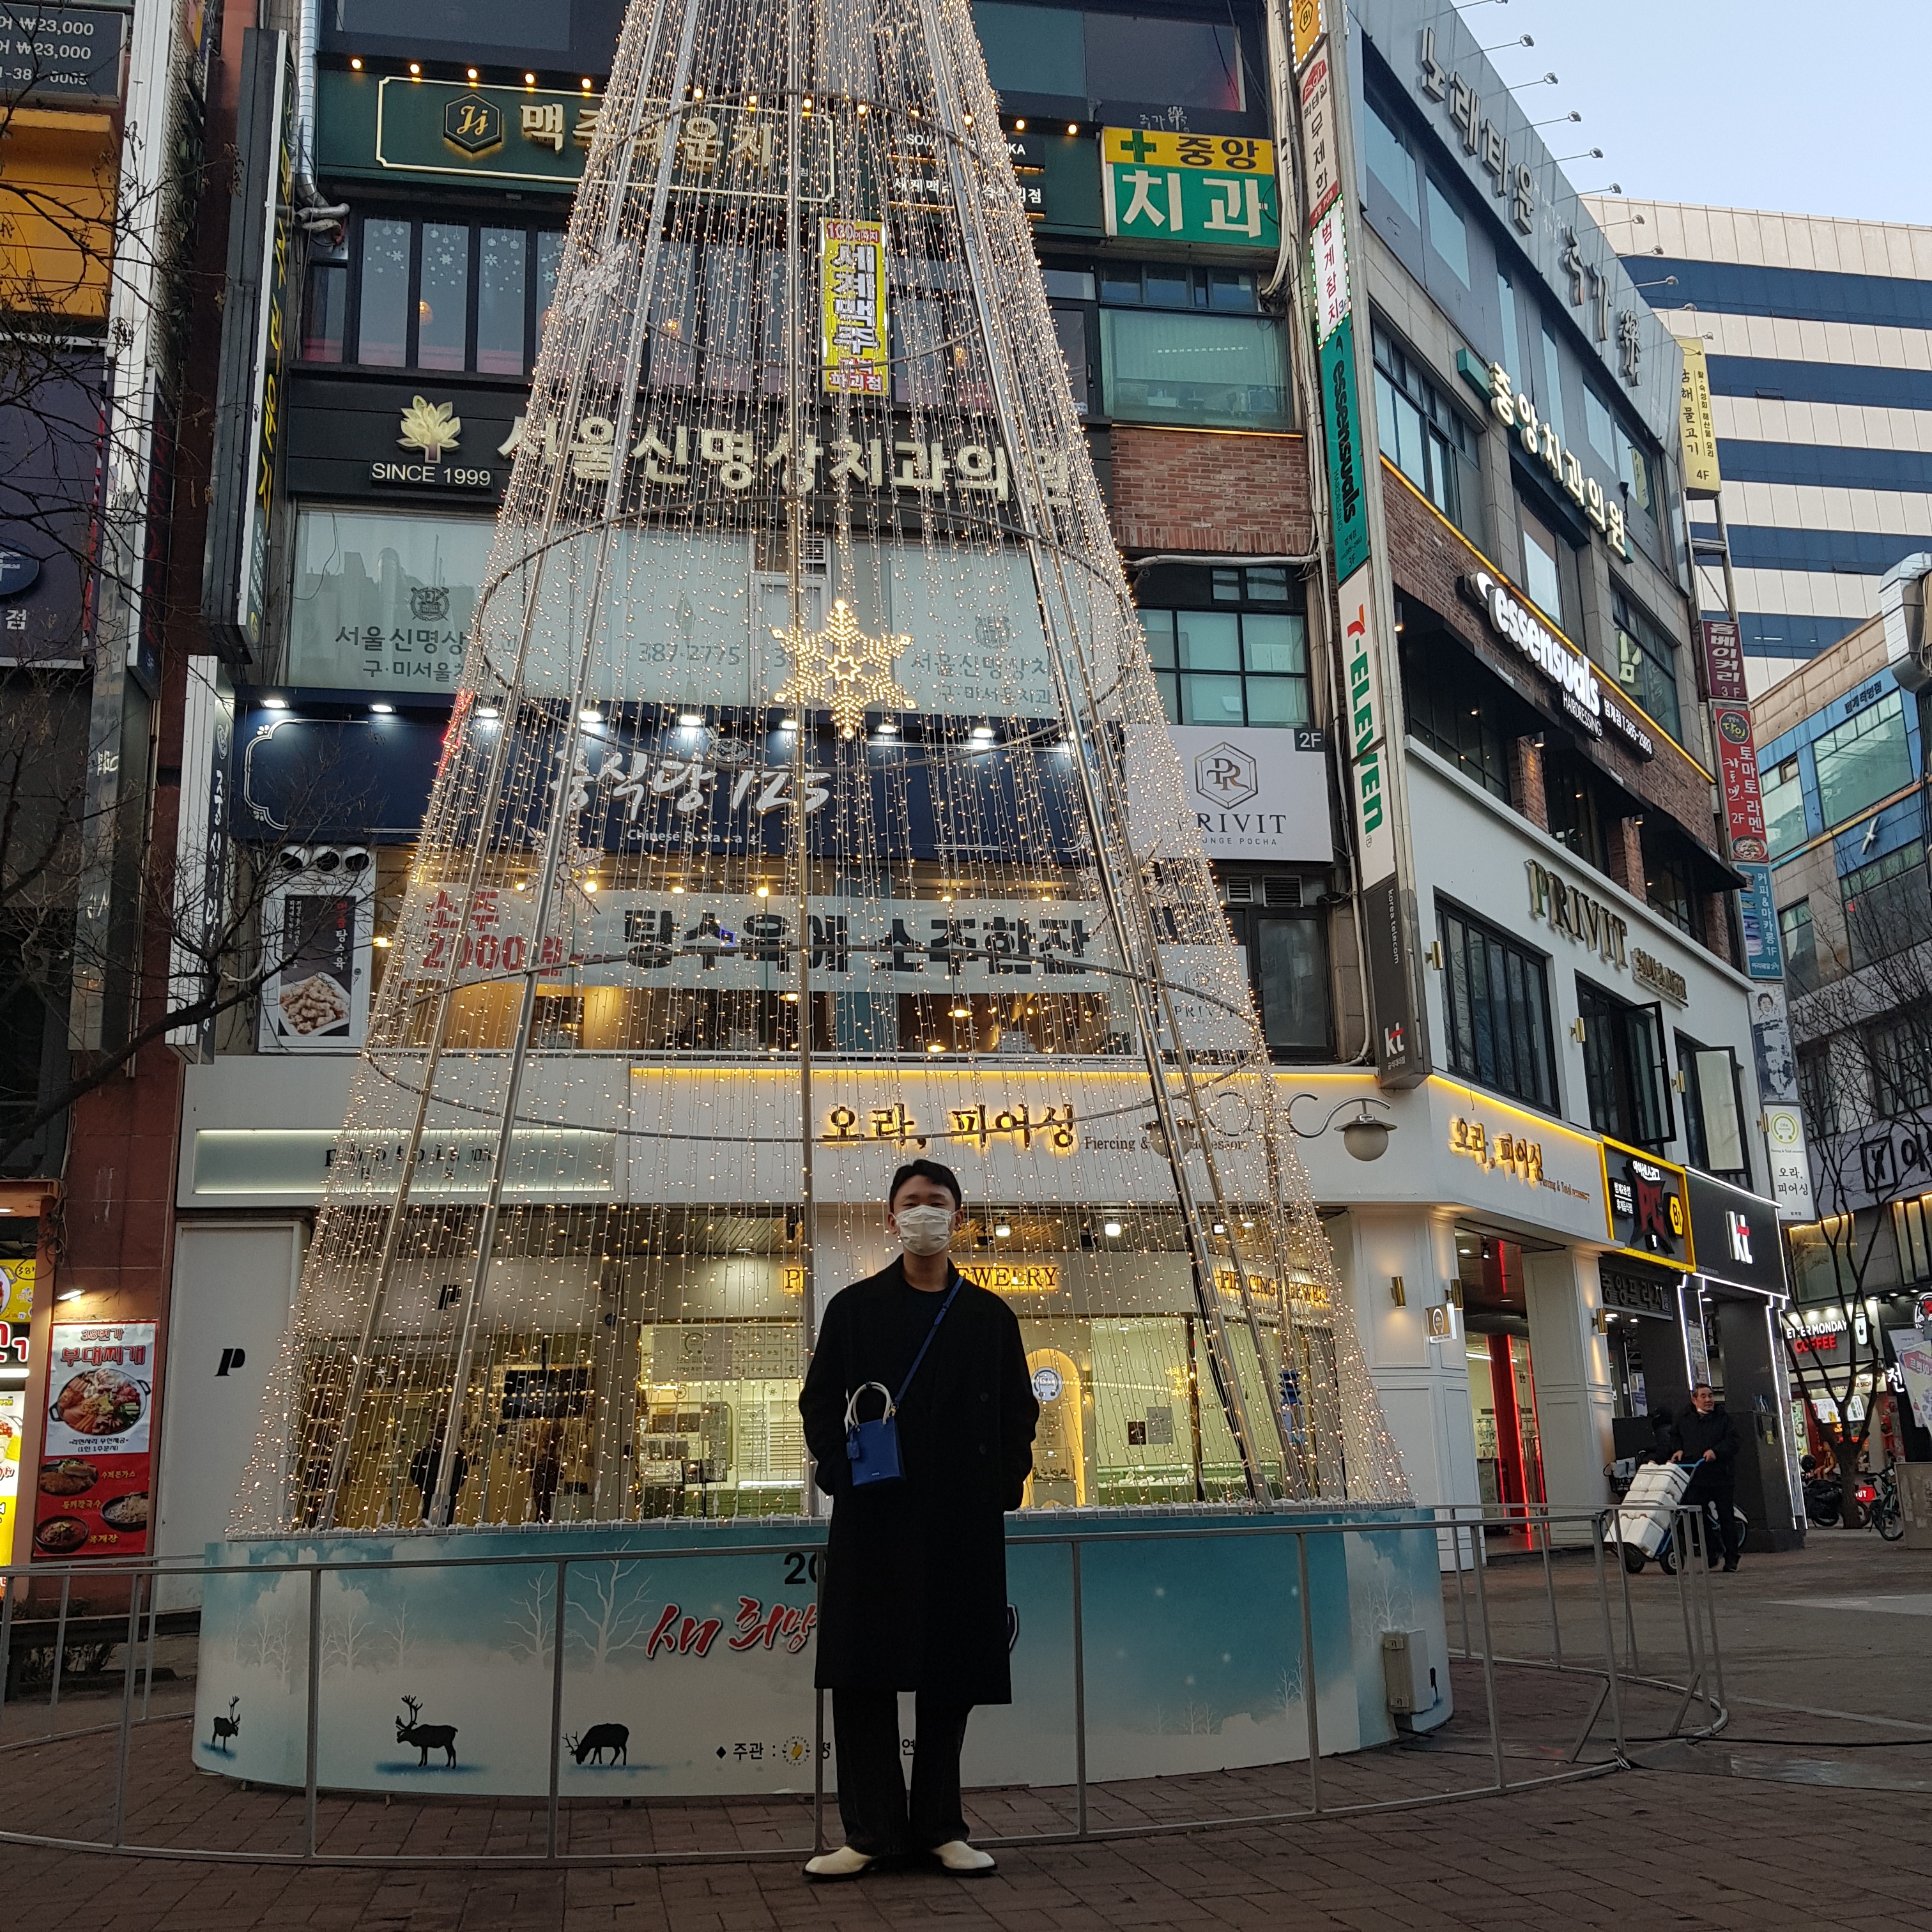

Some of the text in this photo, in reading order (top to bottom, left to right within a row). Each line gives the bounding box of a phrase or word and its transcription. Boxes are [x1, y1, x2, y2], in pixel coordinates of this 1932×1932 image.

[1176, 135, 1260, 170] 중앙
[1310, 111, 1329, 199] 무제한
[1122, 169, 1268, 238] 치과
[1323, 190, 1334, 204] PUB
[1322, 218, 1338, 325] 범계참치
[1489, 361, 1627, 558] 중앙치과의원
[1706, 441, 1714, 458] 요리
[371, 462, 491, 487] SINCE 1999
[1696, 469, 1710, 480] 4F
[1492, 586, 1600, 717] essensuals
[1710, 622, 1740, 683] 홈베이커리
[1562, 691, 1603, 737] HAIRDRESSING
[1299, 732, 1322, 749] 2F
[1740, 746, 1763, 834] 토마토 라멘
[1177, 812, 1287, 834] RIVIT
[1731, 813, 1745, 824] 2F
[1239, 837, 1277, 846] POCHA
[1387, 888, 1399, 964] korea telecom
[1526, 859, 1629, 970] PRIVIT
[1767, 946, 1778, 956] 1F
[1384, 1022, 1404, 1058] kt
[951, 1103, 1075, 1149] 피어싱
[1778, 1183, 1809, 1196] 피어싱
[1726, 1211, 1754, 1265] kt
[81, 1328, 124, 1340] 38번가
[1813, 1319, 1848, 1335] MONDAY
[61, 1345, 146, 1367] 부대찌개
[646, 1602, 723, 1660] 새
[733, 1742, 764, 1760] 주관
